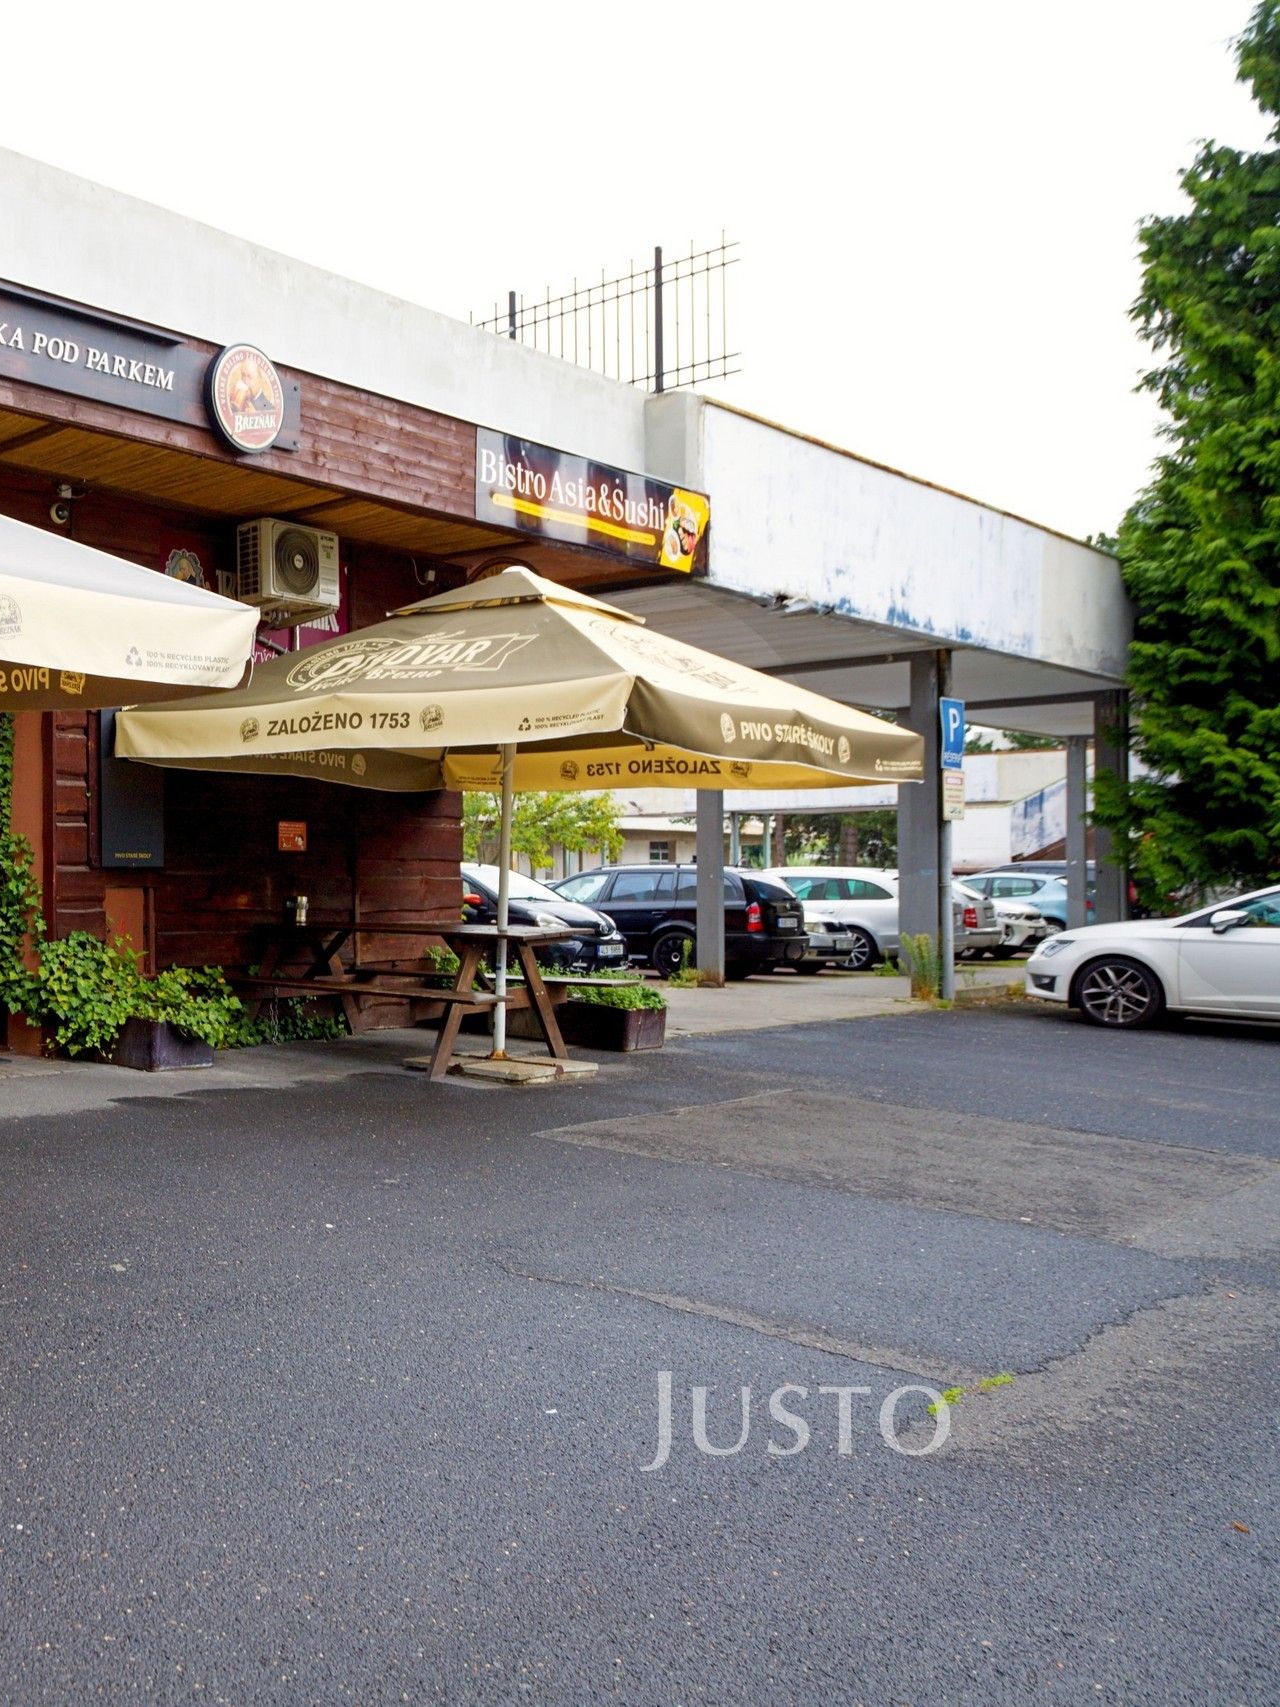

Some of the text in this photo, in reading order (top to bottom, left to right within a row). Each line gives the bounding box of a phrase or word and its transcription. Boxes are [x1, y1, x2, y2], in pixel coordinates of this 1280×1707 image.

[32, 332, 80, 363] POD
[85, 347, 175, 391] PARKEM
[480, 449, 546, 500] Bistro
[266, 711, 411, 737] ZALOŽENO 1753
[740, 721, 835, 755] PIVO STARÉ ŠKOLY
[948, 707, 960, 742] P
